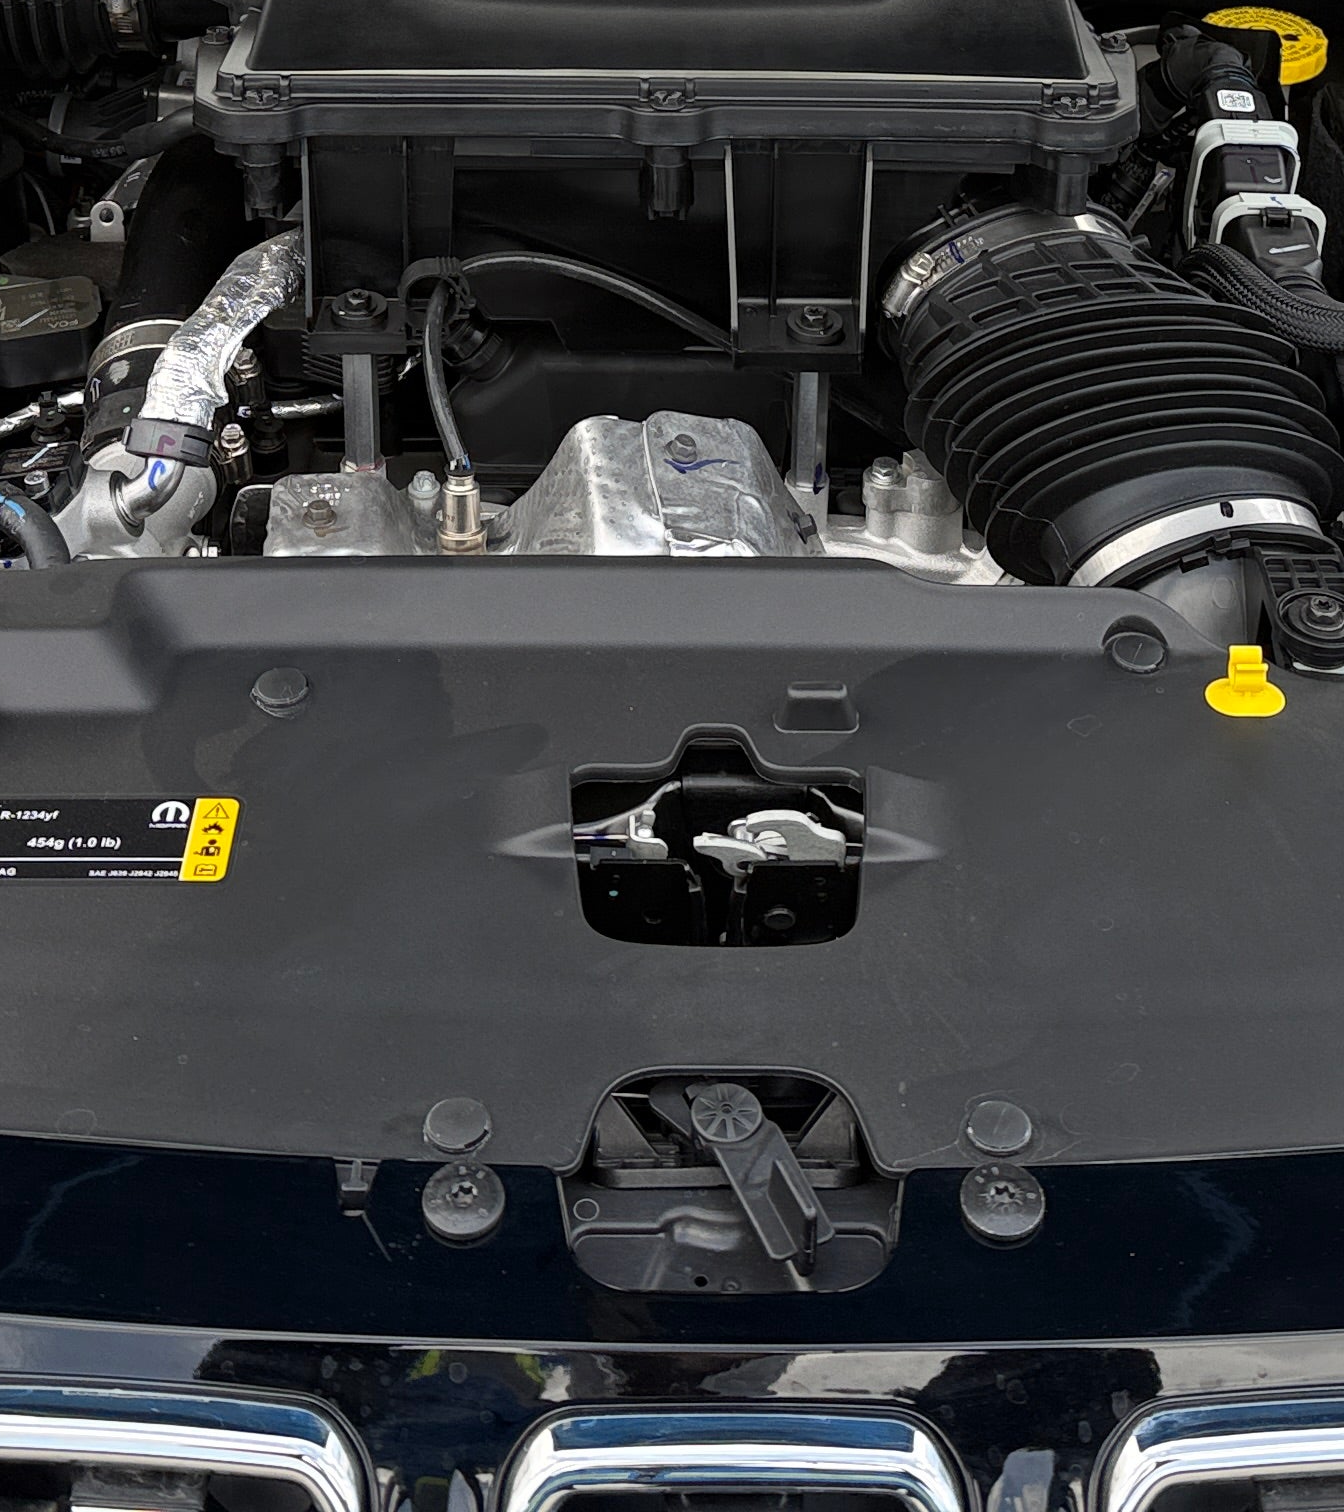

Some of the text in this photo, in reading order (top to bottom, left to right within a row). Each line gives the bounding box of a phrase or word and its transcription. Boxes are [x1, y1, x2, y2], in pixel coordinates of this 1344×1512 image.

[0, 810, 60, 822] R-1234yf
[27, 836, 122, 850] 454g (1.0 lb)
